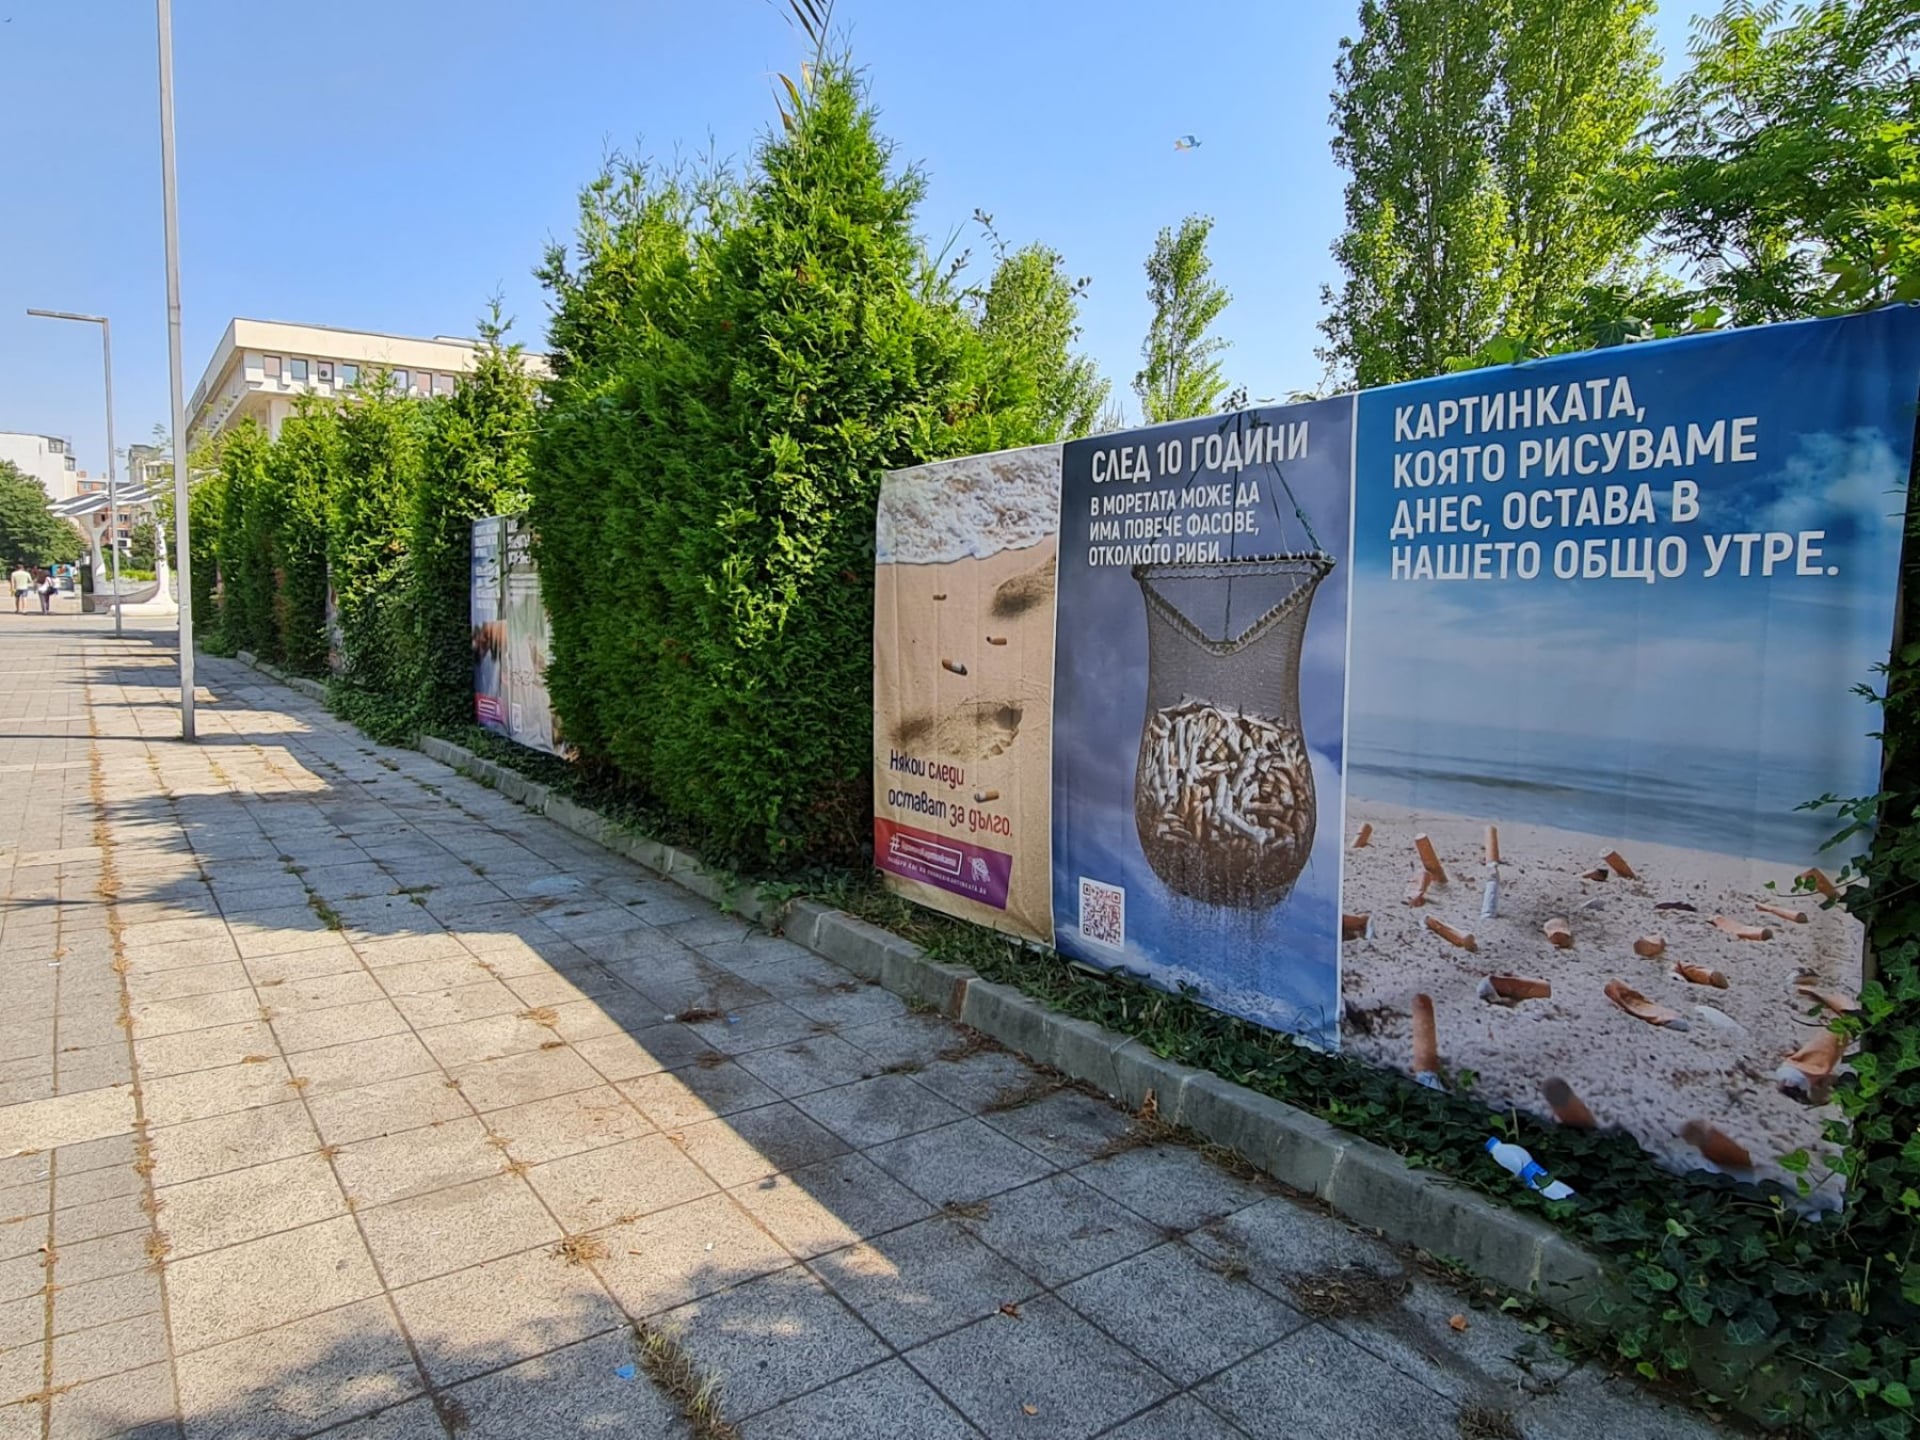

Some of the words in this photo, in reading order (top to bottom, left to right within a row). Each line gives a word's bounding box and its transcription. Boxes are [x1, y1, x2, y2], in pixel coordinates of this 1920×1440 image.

[1395, 376, 1645, 442] КАРТИНКАТА,
[1092, 445, 1150, 483] СЛЕД
[1157, 440, 1182, 475] 10
[1191, 421, 1308, 473] ГОДИНИ
[1394, 443, 1505, 489] КОЯТО
[1519, 417, 1757, 479] РИСУВАМЕ
[1091, 497, 1098, 516] В
[1104, 490, 1176, 515] МОРЕТАТА
[1181, 484, 1231, 509] МОЖЕ
[1235, 481, 1260, 506] ДА
[1390, 495, 1490, 540] ДНЕС,
[1503, 482, 1655, 530] ОСТАВА
[1672, 480, 1699, 523] В
[1090, 520, 1120, 541] ИМА
[1124, 515, 1182, 539] ПОВЕЧЕ
[1187, 511, 1259, 536] ФАСОВЕ,
[1089, 543, 1171, 567] ОТКОЛКОТО
[1176, 541, 1223, 564] РИБИ.
[1391, 541, 1540, 581] НАШЕТО
[1553, 536, 1687, 584] ОБЩО
[1703, 531, 1840, 578] УТРЕ.
[890, 749, 925, 777] Някои
[928, 761, 964, 789] следи
[889, 789, 946, 818] остават
[950, 803, 964, 827] за
[969, 809, 1012, 838] дълго.
